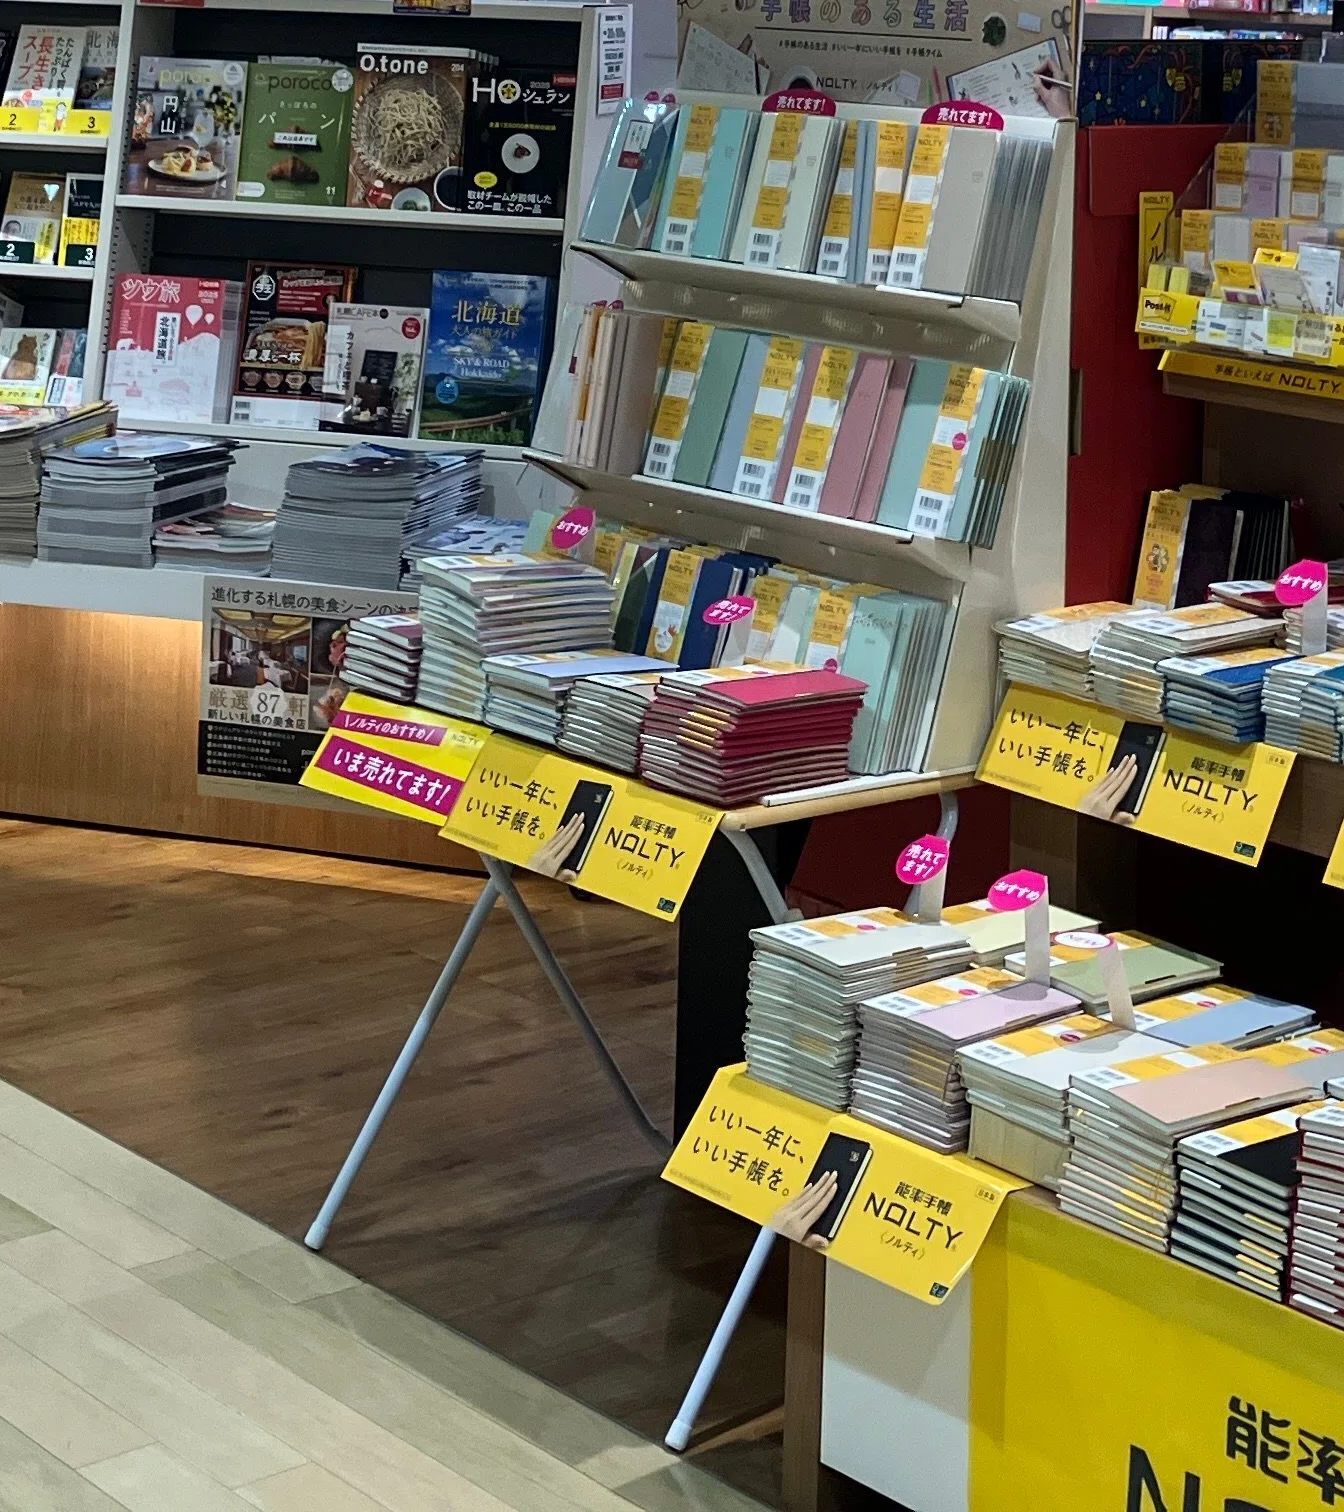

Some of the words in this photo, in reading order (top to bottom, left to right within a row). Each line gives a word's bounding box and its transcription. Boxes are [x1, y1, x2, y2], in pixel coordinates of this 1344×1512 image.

[359, 53, 429, 75] O.tone
[268, 74, 333, 93] poroco
[815, 76, 857, 90] NOLTY
[160, 95, 179, 134] 円山
[776, 94, 825, 111] 売れてます！
[8, 113, 17, 127] 2
[87, 116, 96, 129] 3
[936, 106, 993, 125] 売れてます！
[6, 243, 16, 257] 2
[85, 247, 94, 260] 3
[451, 299, 523, 326] 北海道
[1278, 372, 1341, 393] NOLTY
[1278, 570, 1325, 593] おすすめ
[207, 709, 306, 730] 新しい札幌の美食店
[1009, 706, 1106, 754] いい一年に、
[997, 734, 1096, 784] いい手帳を。
[1189, 755, 1247, 783] 能率手帳
[333, 748, 452, 807] いま売れてます！
[479, 768, 559, 810] いい一年に、
[1162, 768, 1259, 812] NOLTY
[465, 796, 547, 841] いい手帳を。
[628, 814, 679, 839] 能率手帳
[604, 825, 687, 868] NOLTY
[906, 841, 944, 866] 売れて
[903, 858, 936, 878] ます！
[994, 880, 1040, 902] おすすめ
[708, 1104, 805, 1166] いい一年に、
[691, 1135, 791, 1198] いい手帳を。
[893, 1181, 954, 1217] 能率手帳
[862, 1191, 964, 1250] NOLTY
